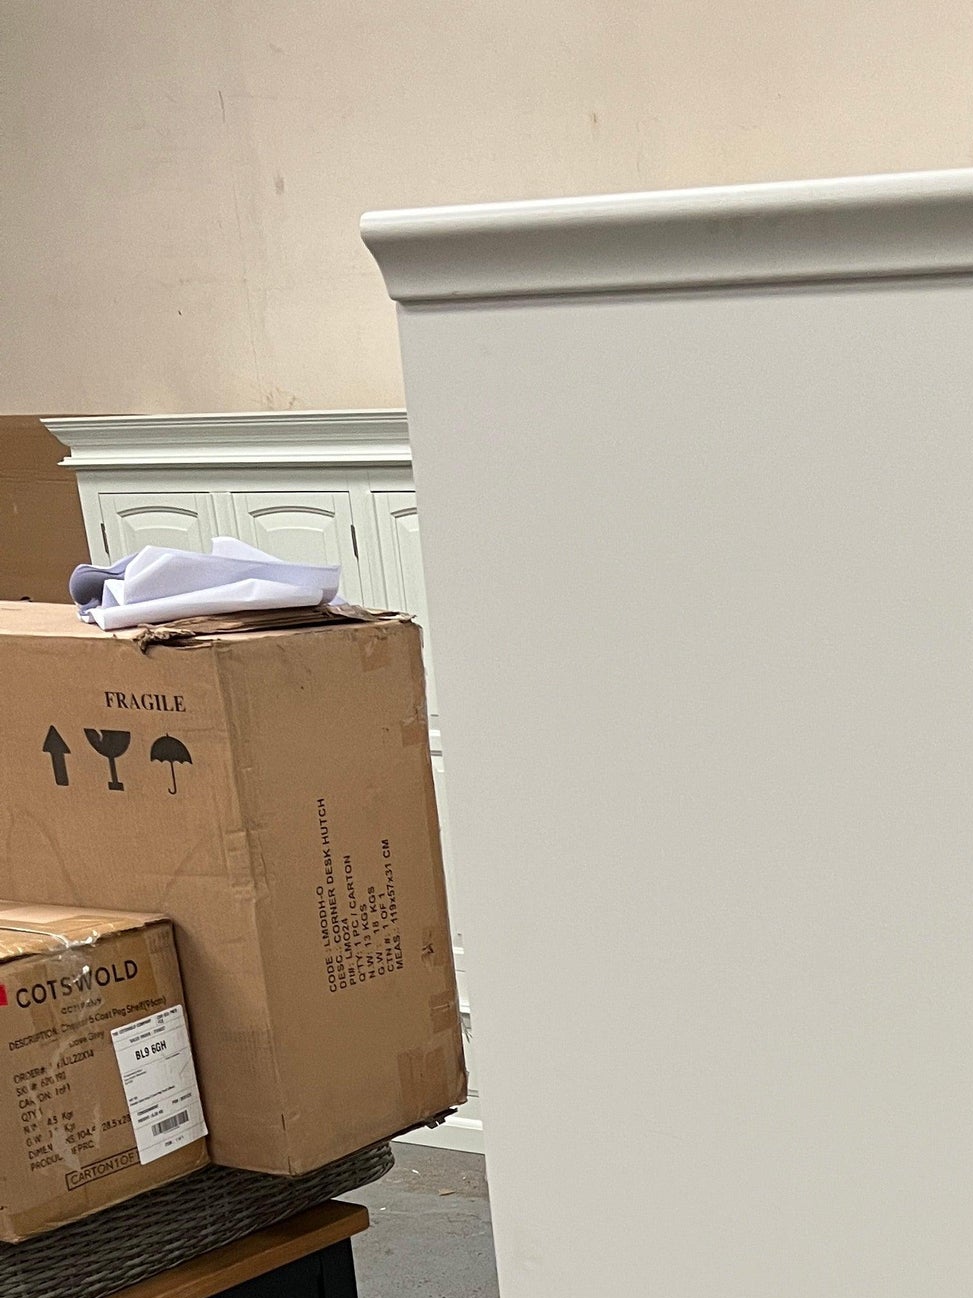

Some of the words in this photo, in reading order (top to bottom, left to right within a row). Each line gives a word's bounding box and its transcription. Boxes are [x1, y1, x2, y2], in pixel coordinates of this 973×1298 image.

[104, 691, 186, 712] FRAGILE
[317, 798, 330, 845] HUTCH
[381, 839, 391, 858] CM
[323, 848, 334, 884] DESK
[343, 855, 356, 909] CARTON
[368, 886, 377, 913] KGS
[380, 903, 388, 920] OF
[328, 888, 341, 943] CORNER
[352, 920, 360, 937] PC
[360, 904, 369, 931] KGS
[372, 921, 379, 934] 18
[364, 935, 372, 947] 13
[386, 948, 394, 972] CTN
[16, 959, 138, 1009] COTSWOLD
[325, 956, 337, 993] CODE
[135, 1046, 150, 1060] BL9
[151, 1040, 167, 1054] 6GH
[70, 1160, 114, 1186] CARTON
